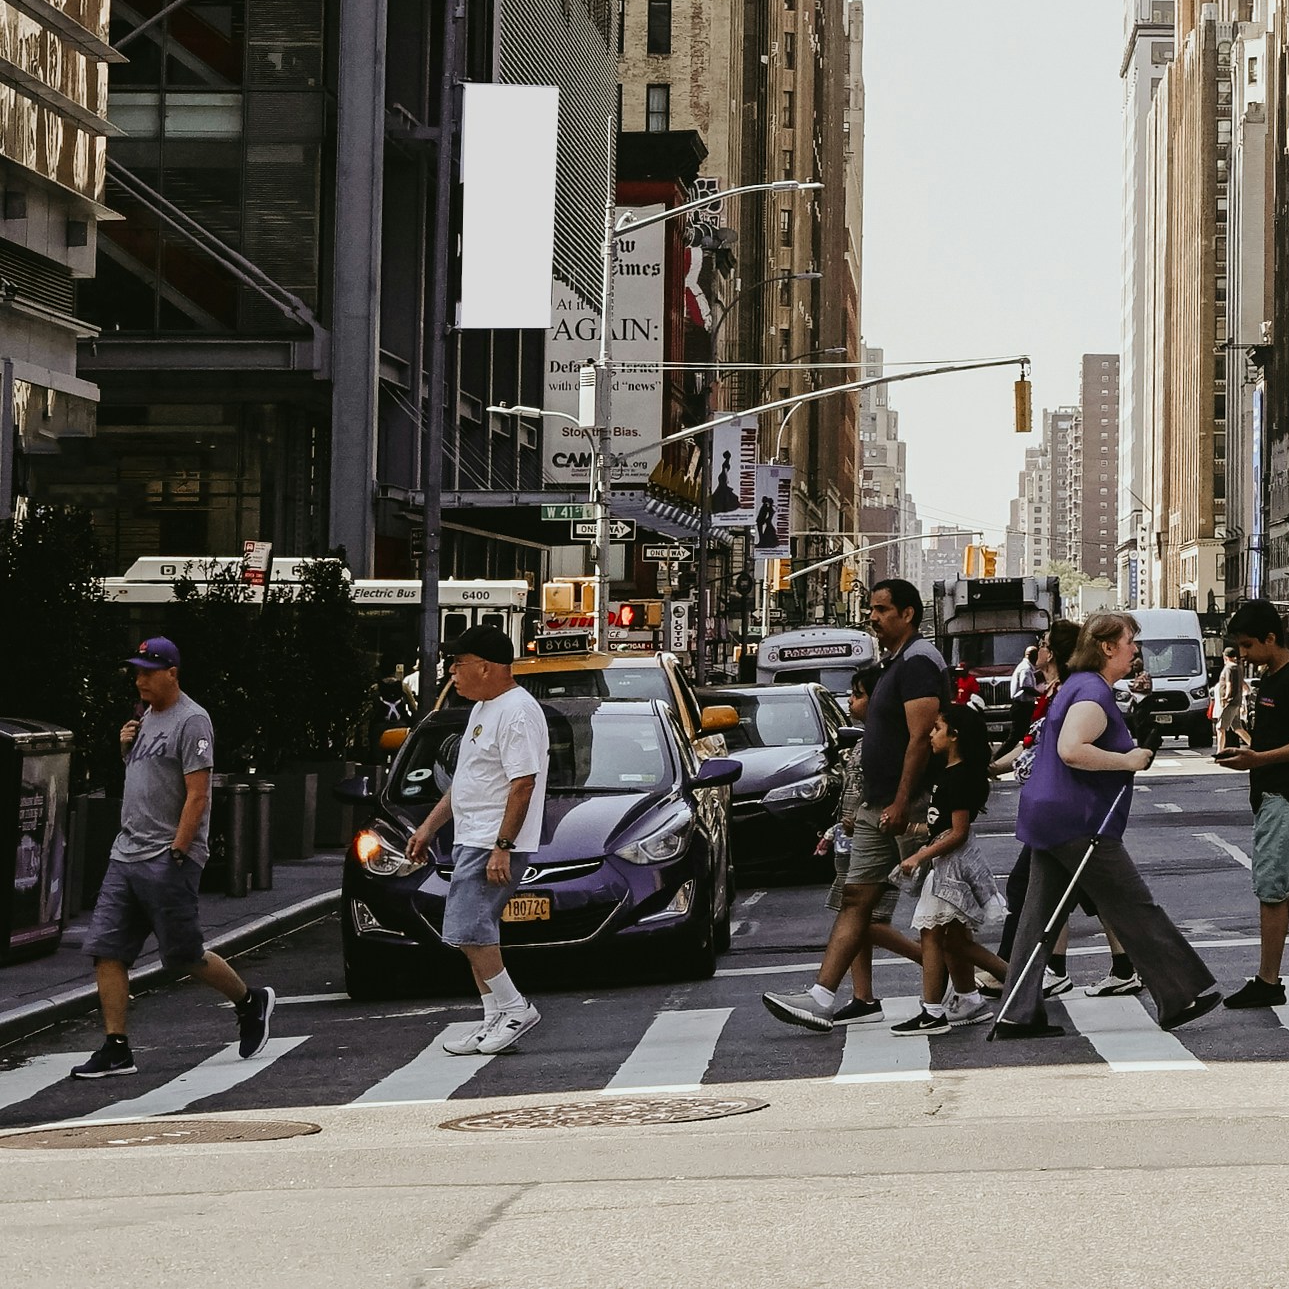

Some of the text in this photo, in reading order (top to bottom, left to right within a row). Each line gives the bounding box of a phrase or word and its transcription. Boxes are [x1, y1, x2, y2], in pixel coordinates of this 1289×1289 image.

[613, 427, 641, 437] Bias.
[650, 549, 686, 557] ONE WAY
[353, 588, 416, 599] Electric Bus
[462, 591, 490, 600] 6400
[673, 620, 682, 647] LOTTO
[545, 638, 579, 651] 8Y64
